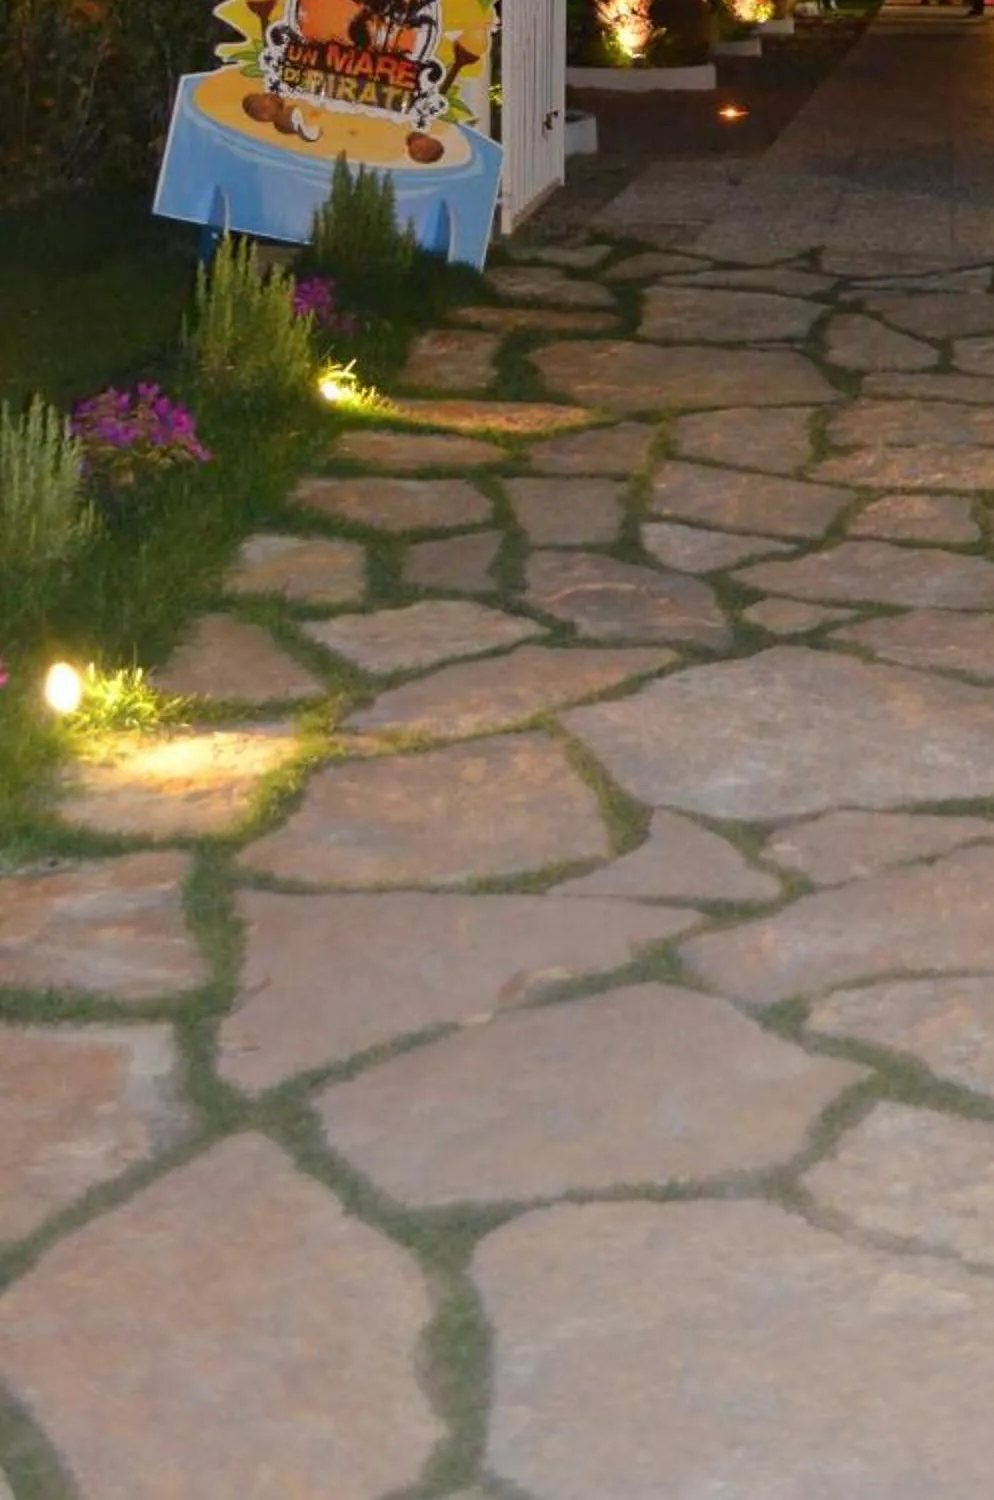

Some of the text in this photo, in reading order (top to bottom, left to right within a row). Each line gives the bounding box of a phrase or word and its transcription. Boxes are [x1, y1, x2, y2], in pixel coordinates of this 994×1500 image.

[286, 42, 417, 90] UN MARE
[302, 69, 413, 114] PIRATI
